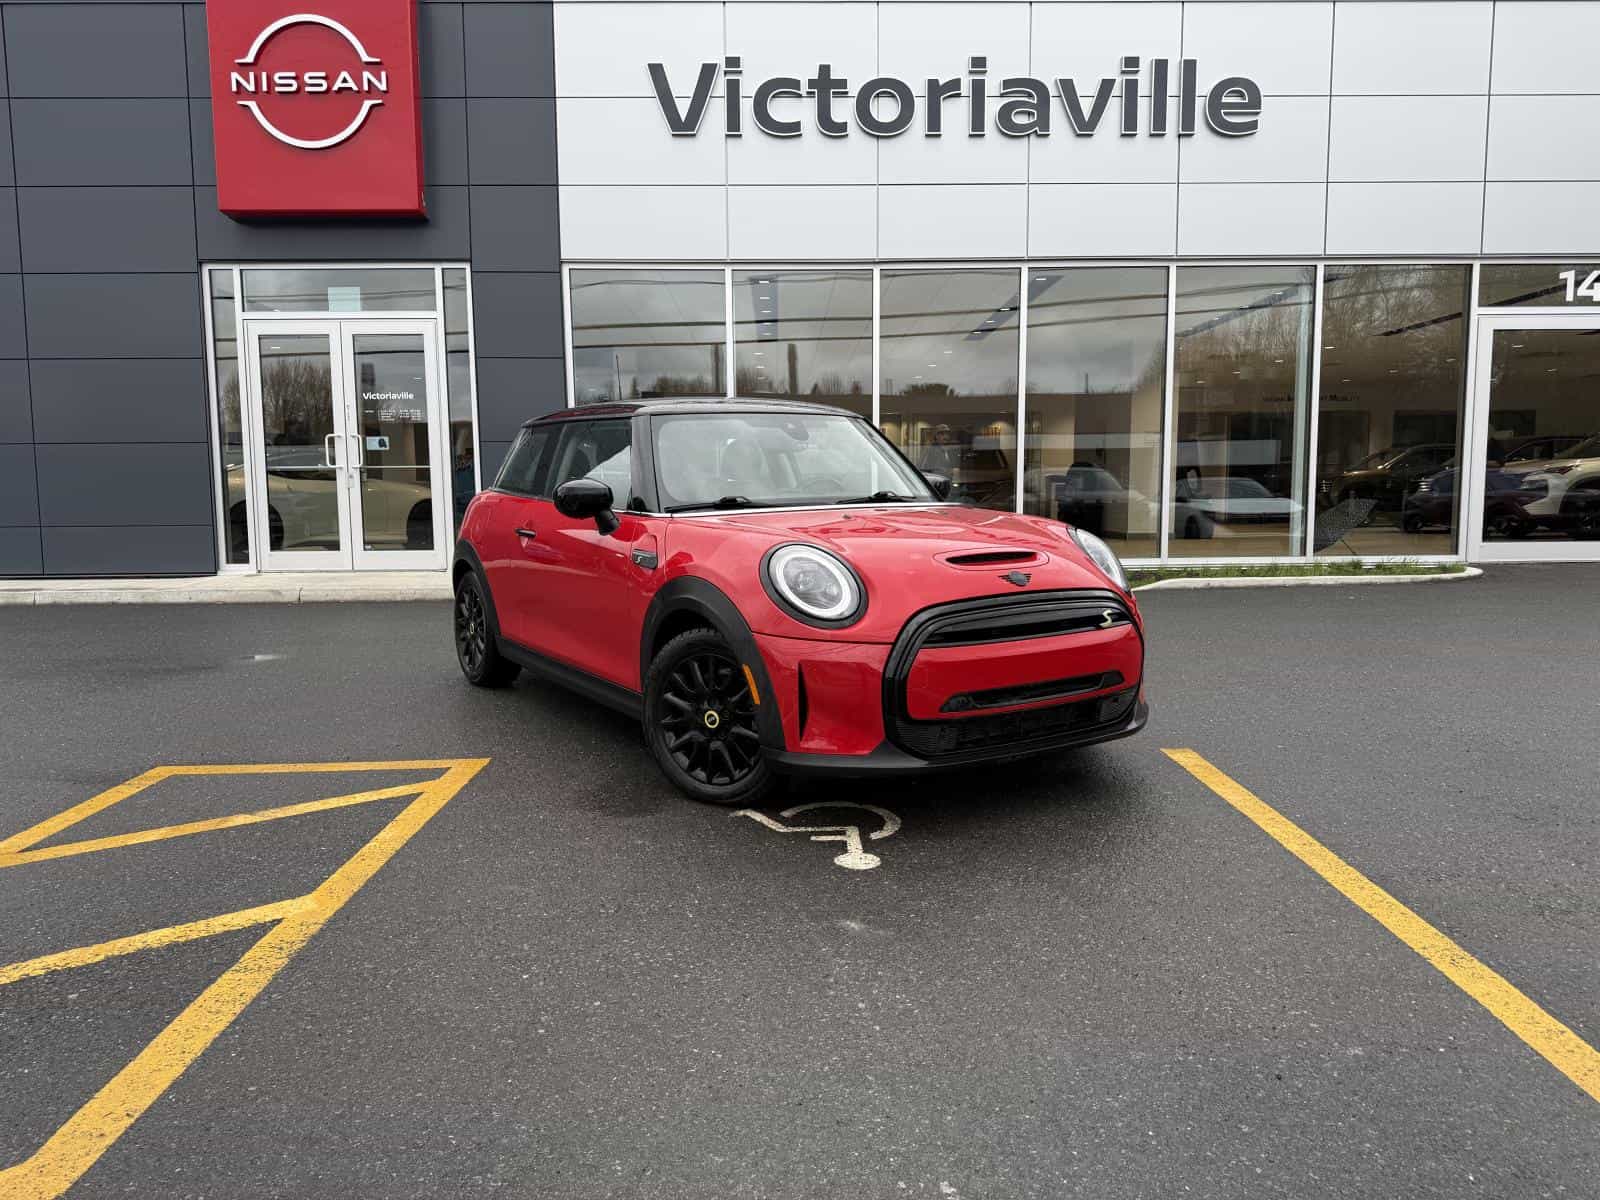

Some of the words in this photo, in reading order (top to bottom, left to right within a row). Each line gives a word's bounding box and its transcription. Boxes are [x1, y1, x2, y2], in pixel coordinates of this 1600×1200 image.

[230, 71, 388, 93] NISSAN
[648, 56, 1263, 137] Victoriaville
[1559, 269, 1600, 302] 14
[362, 391, 415, 400] Victoriaville
